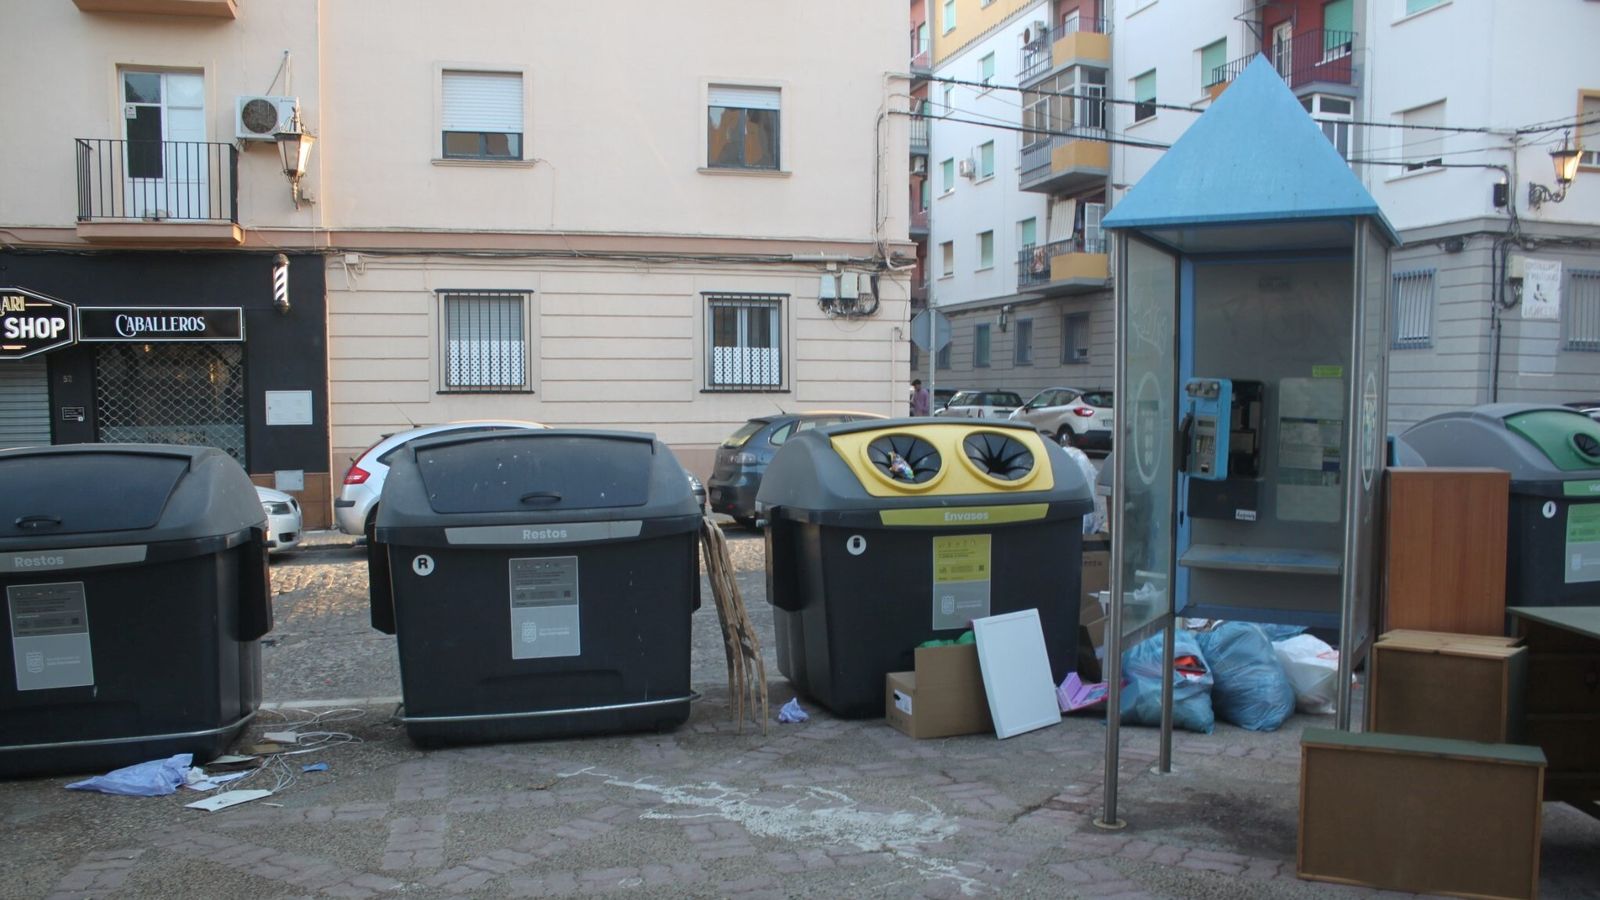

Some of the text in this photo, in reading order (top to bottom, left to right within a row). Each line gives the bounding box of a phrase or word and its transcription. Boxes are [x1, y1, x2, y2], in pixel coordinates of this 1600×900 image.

[4, 317, 66, 339] SHOP
[115, 315, 206, 337] CABALLEROS
[944, 512, 989, 521] Envases
[522, 529, 568, 541] Restos
[14, 555, 64, 568] Restos
[418, 559, 428, 569] R
